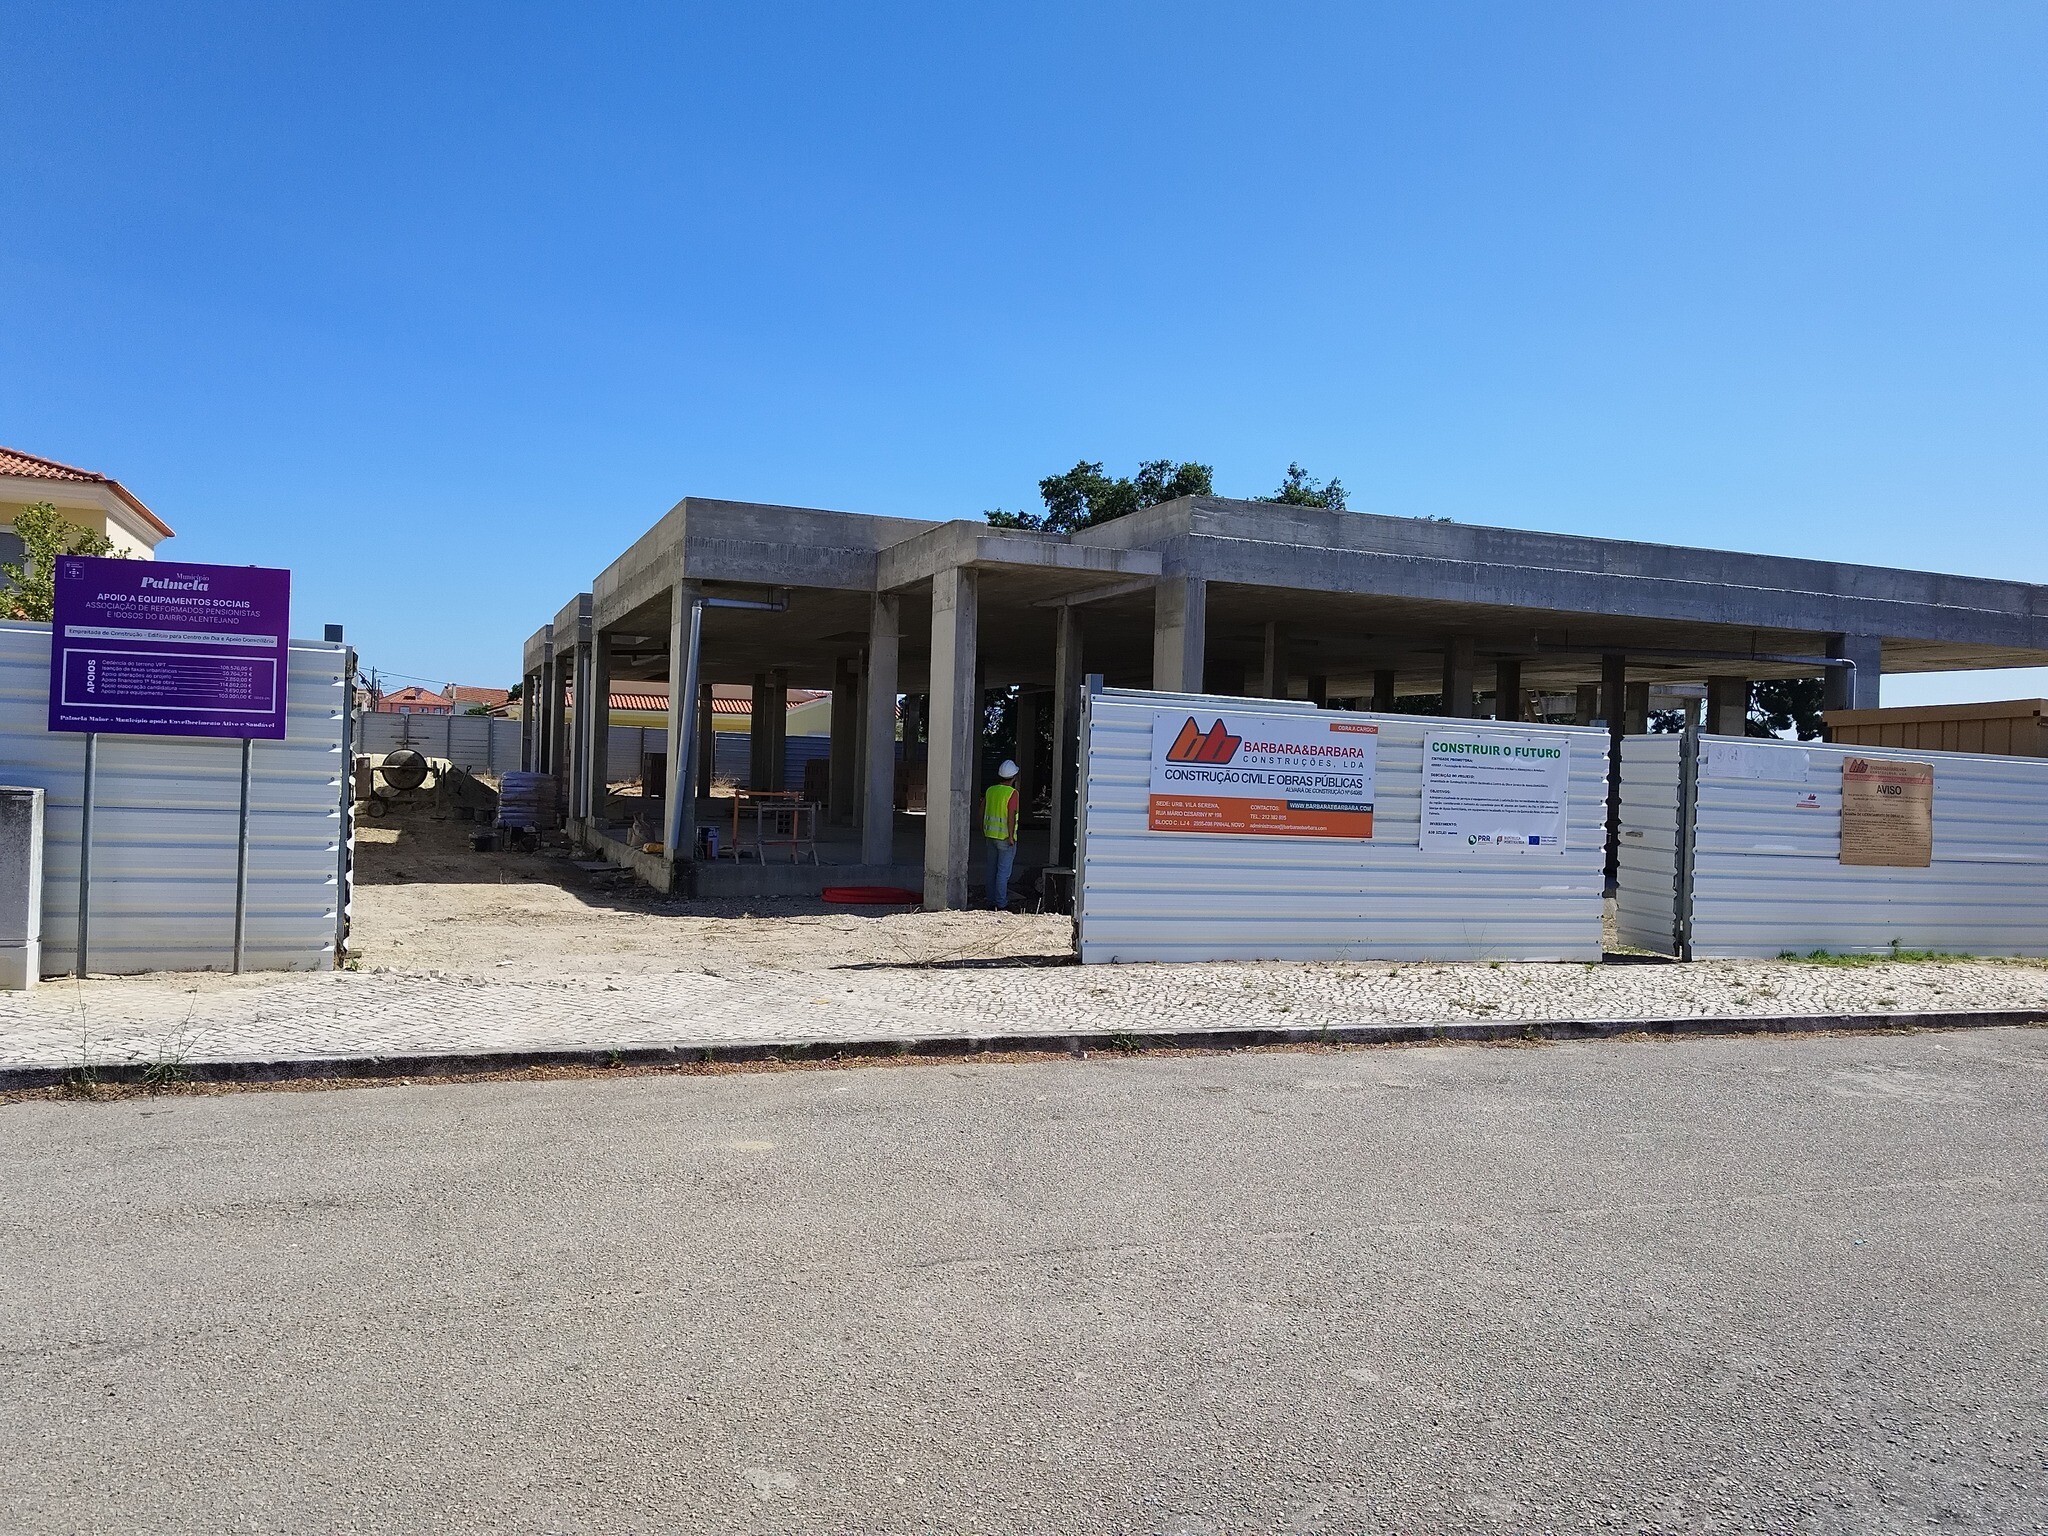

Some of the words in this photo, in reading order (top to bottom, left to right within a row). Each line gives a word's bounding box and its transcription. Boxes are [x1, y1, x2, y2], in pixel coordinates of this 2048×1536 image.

[140, 576, 209, 591] Palmela
[97, 593, 127, 602] APOIO
[129, 594, 136, 602] A
[138, 595, 211, 606] EQUIPAMENTOS
[212, 600, 250, 608] SOCIAIS
[86, 601, 136, 611] ASSOCIAÇÃO
[150, 604, 204, 614] REFORMADOS
[206, 608, 261, 618] PENSIONISTAS
[114, 612, 144, 620] IDOSOS
[159, 614, 188, 622] BAIRRO
[188, 616, 240, 625] ALENTEJANO
[86, 660, 96, 694] APOIOS
[1244, 742, 1364, 758] BARBARA&BARBARA
[1432, 742, 1500, 755] CONSTRUIR
[1504, 746, 1511, 756] O
[1515, 747, 1561, 758] FUTURO
[1165, 769, 1240, 784] CONSTRUÇÃO
[1242, 773, 1266, 784] CIVIL
[1268, 774, 1274, 784] E
[1277, 775, 1312, 786] OBRAS
[1315, 774, 1363, 788] PÚBLICAS
[1876, 785, 1902, 795] AVISO
